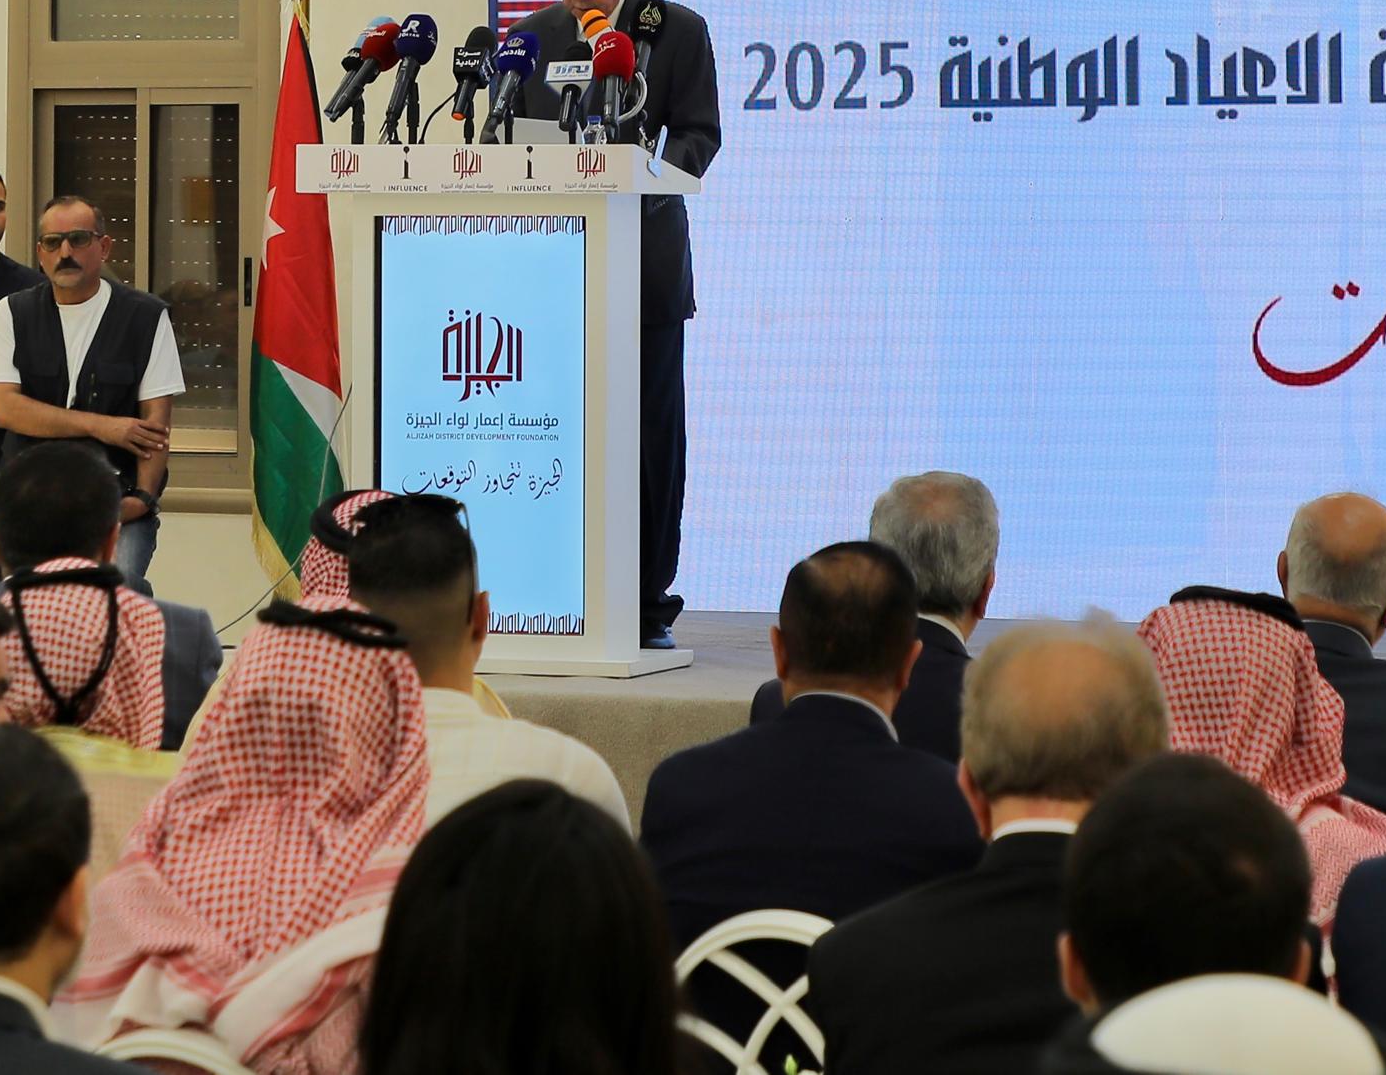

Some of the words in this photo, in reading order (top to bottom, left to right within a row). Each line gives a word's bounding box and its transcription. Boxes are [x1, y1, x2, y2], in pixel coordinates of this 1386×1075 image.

[744, 42, 913, 110] 2025
[940, 36, 1139, 122] الوطنية
[1165, 32, 1342, 119] الاعياد
[406, 412, 441, 429] الجيزة
[406, 432, 434, 440] ALJIZAH
[435, 432, 465, 440] DISTRICT
[466, 432, 515, 441] DEVELOPMENT
[516, 433, 559, 441] FOUNDATION
[447, 412, 468, 429] لواء
[474, 413, 503, 430] إعمار
[508, 413, 558, 430] مؤسسة
[402, 460, 476, 494] التوقعات
[483, 462, 520, 495] تتجاوز
[529, 458, 562, 500] الجيزة
